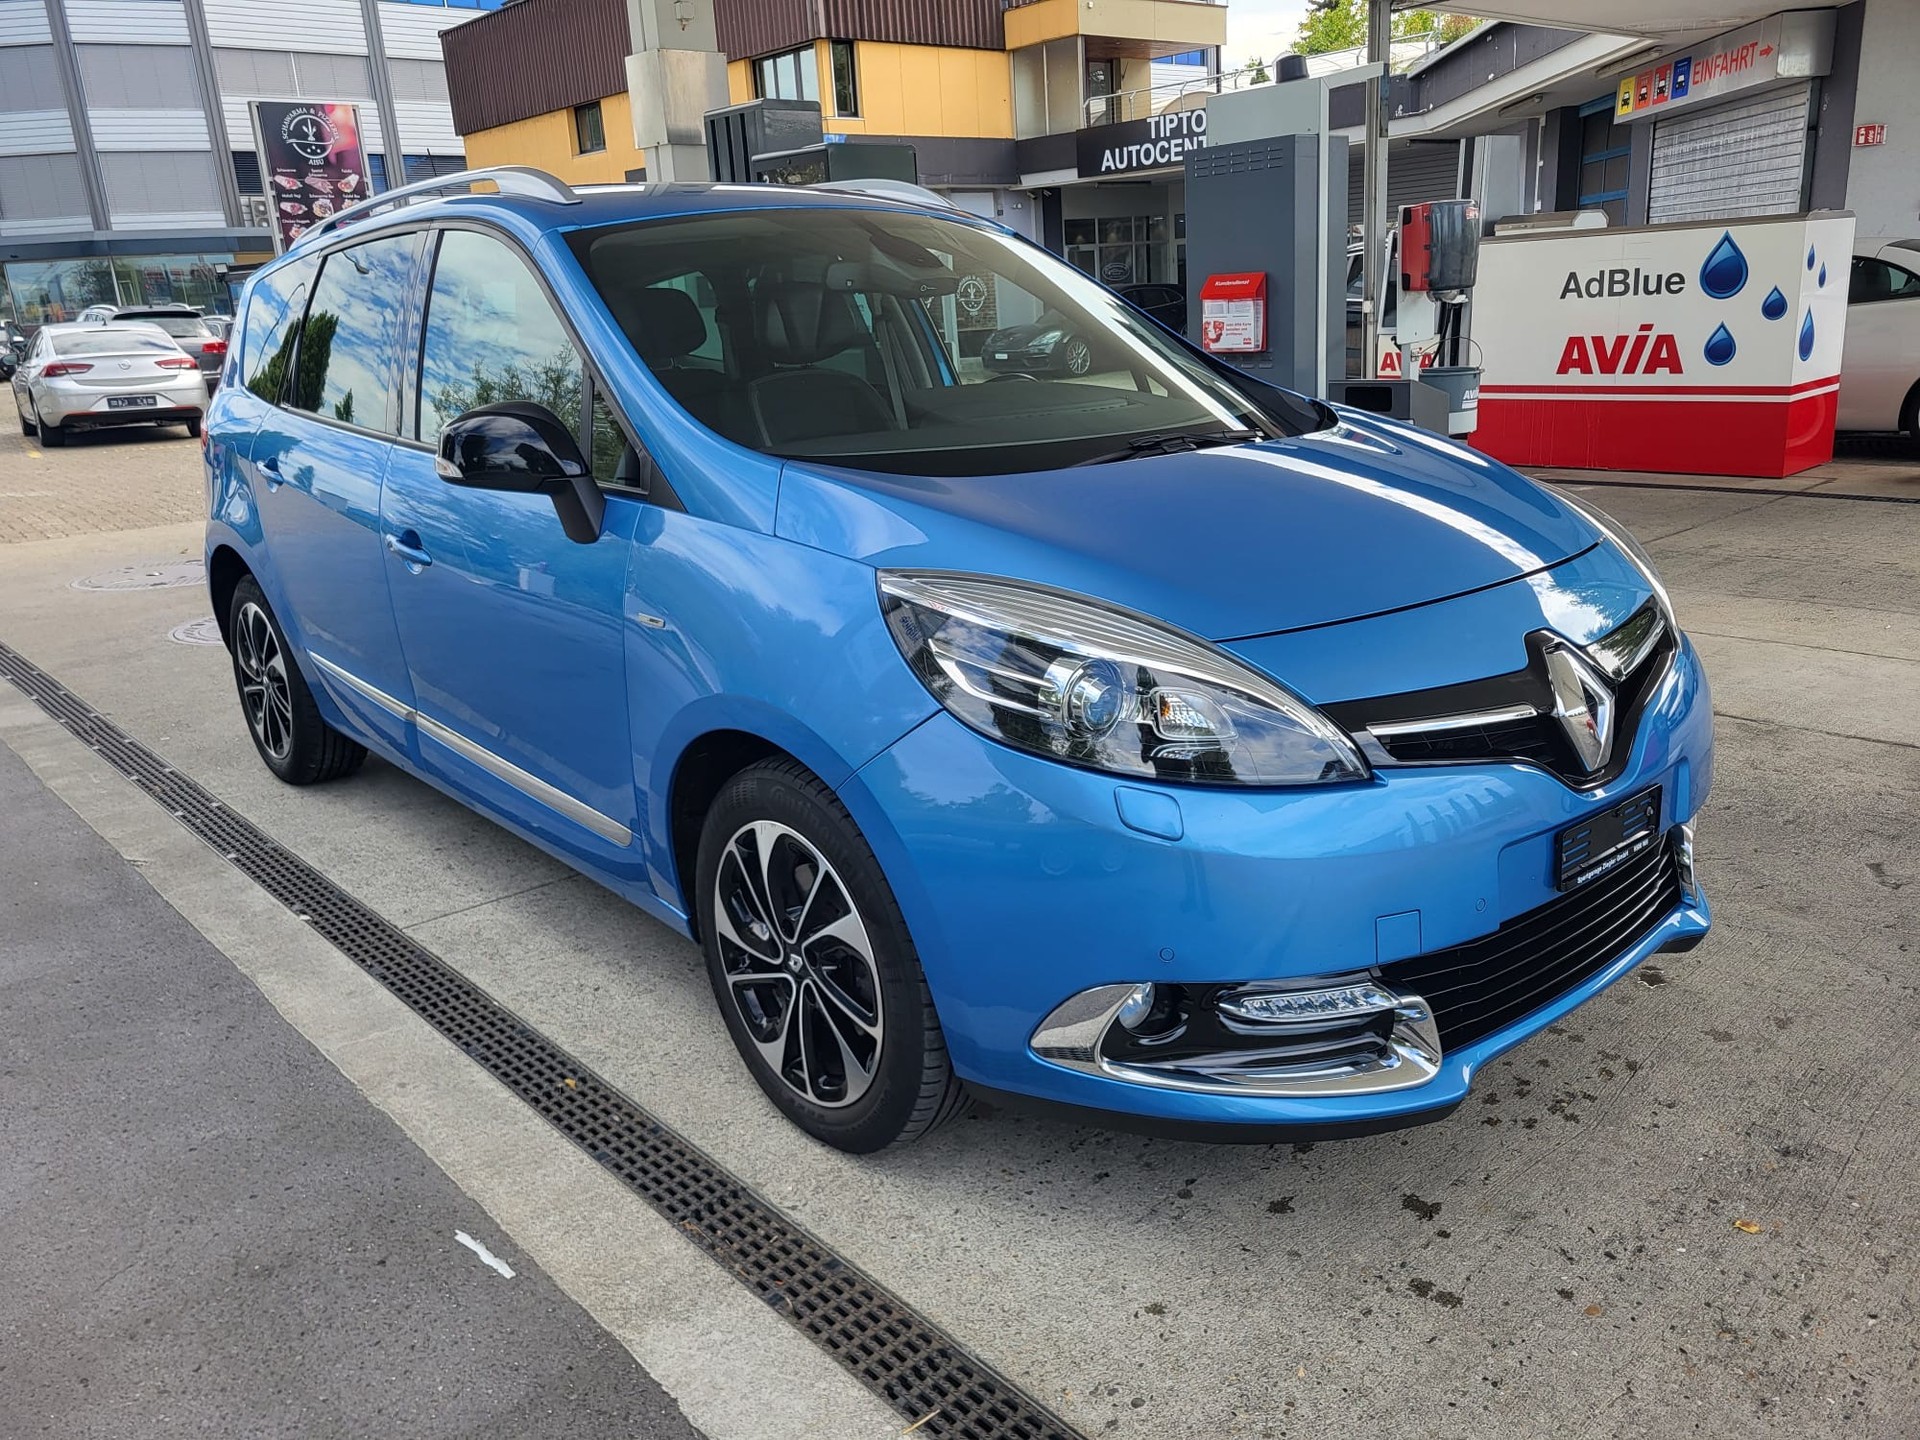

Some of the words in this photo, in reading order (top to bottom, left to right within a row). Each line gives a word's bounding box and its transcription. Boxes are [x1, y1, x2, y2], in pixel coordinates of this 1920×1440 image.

[1691, 41, 1758, 86] EINFAHRT
[281, 107, 308, 140] SCHAWARMA
[309, 107, 316, 115] &
[1146, 109, 1207, 139] TIPTO
[1560, 267, 1686, 300] AdBlue
[1556, 323, 1684, 375] AVIA
